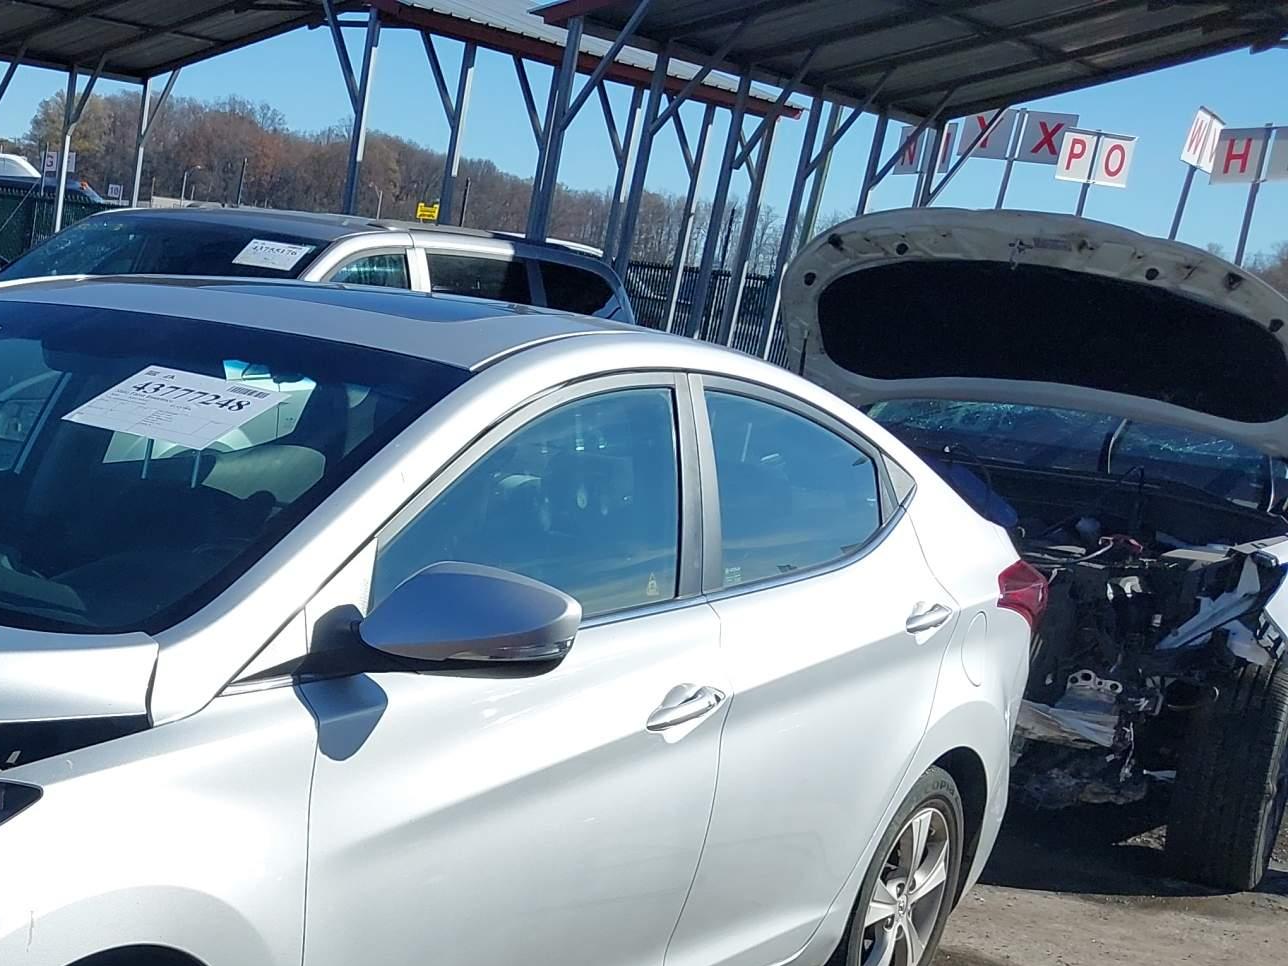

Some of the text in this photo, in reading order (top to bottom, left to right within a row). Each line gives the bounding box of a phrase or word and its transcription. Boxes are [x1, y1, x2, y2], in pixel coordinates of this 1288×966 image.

[1030, 121, 1064, 156] X
[1223, 137, 1253, 174] H
[132, 380, 251, 412] 43777248
